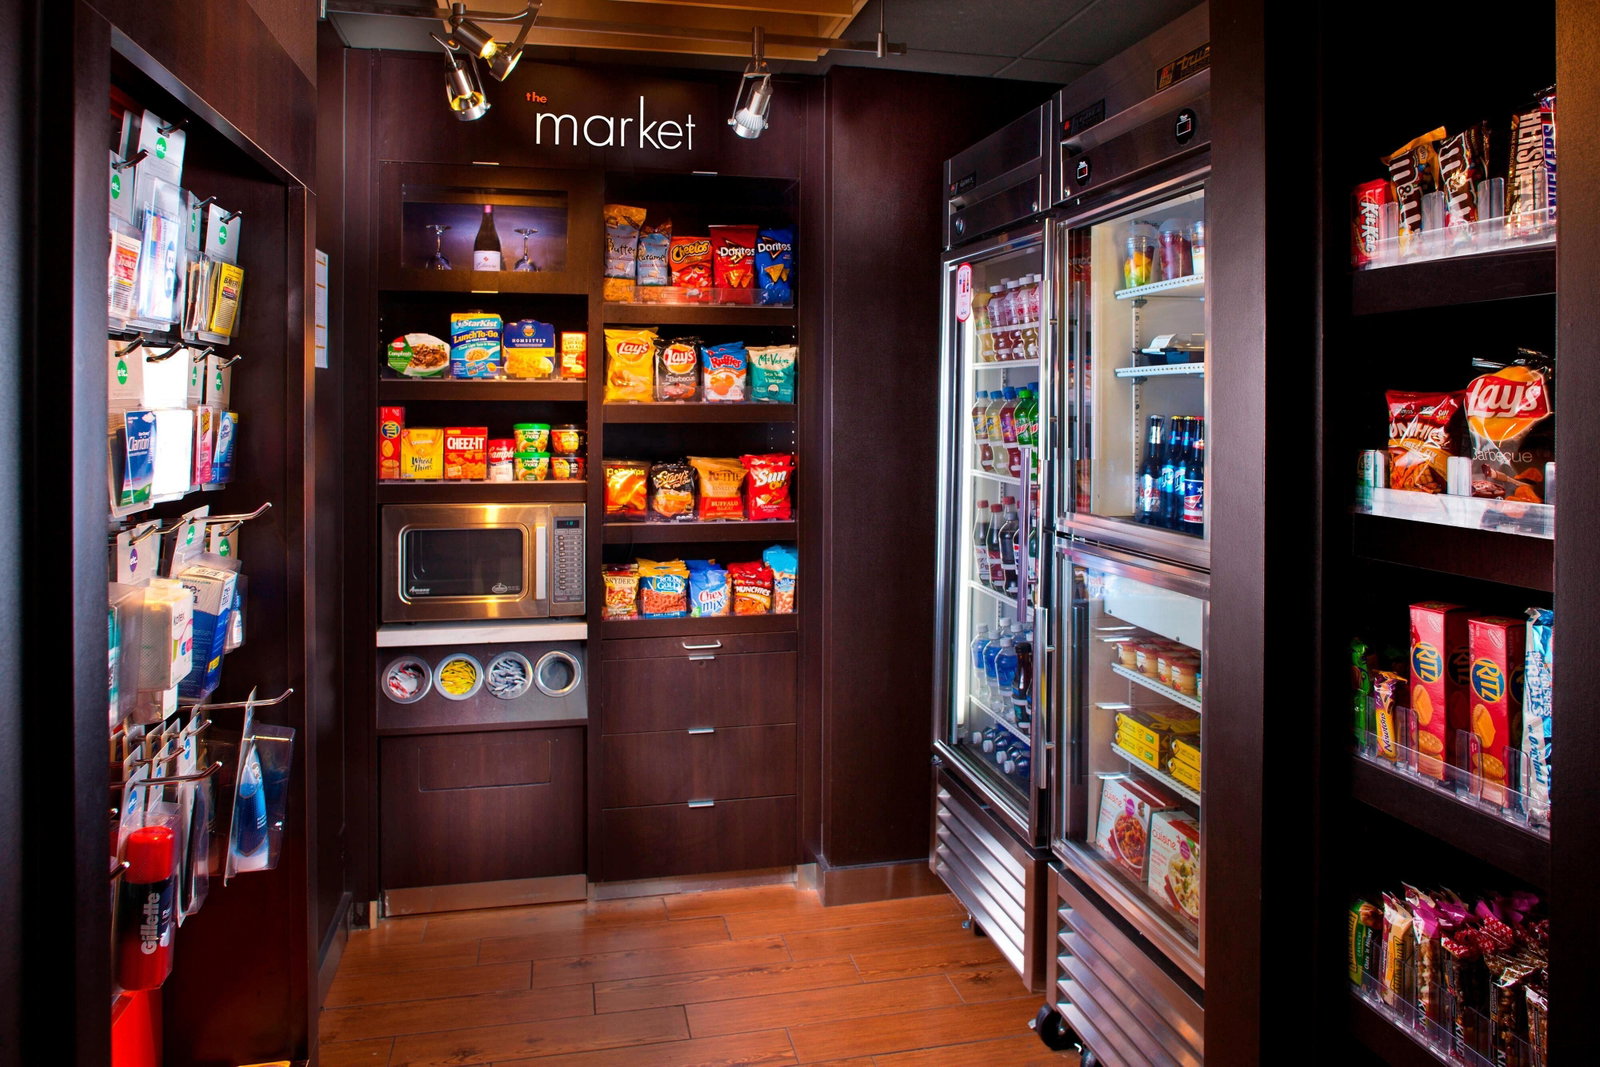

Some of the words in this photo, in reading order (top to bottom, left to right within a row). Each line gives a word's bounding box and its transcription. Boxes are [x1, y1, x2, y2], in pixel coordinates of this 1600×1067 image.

[525, 91, 548, 104] the
[535, 95, 696, 150] market
[671, 241, 710, 262] Cheetos
[757, 242, 792, 252] Doritos
[462, 320, 498, 328] StarKist
[618, 342, 649, 355] Lay's
[667, 348, 695, 365] Lay's
[711, 355, 742, 368] Ruffles
[1466, 377, 1541, 418] Lay's
[129, 436, 151, 451] Claritin
[447, 437, 484, 450] CHEEZ-IT
[656, 470, 690, 488] Stacy's
[755, 470, 788, 487] Sun
[605, 577, 636, 585] SNYDER'S
[656, 582, 681, 590] GOLD
[698, 590, 724, 602] Chex
[735, 586, 771, 596] MUNCHIES
[1415, 642, 1440, 682] RITZ
[1474, 659, 1501, 701] RITZ
[1525, 651, 1544, 716] TREATS
[1378, 711, 1394, 753] Newtons
[140, 892, 161, 955] Gillette
[1455, 1022, 1465, 1057] KIND
